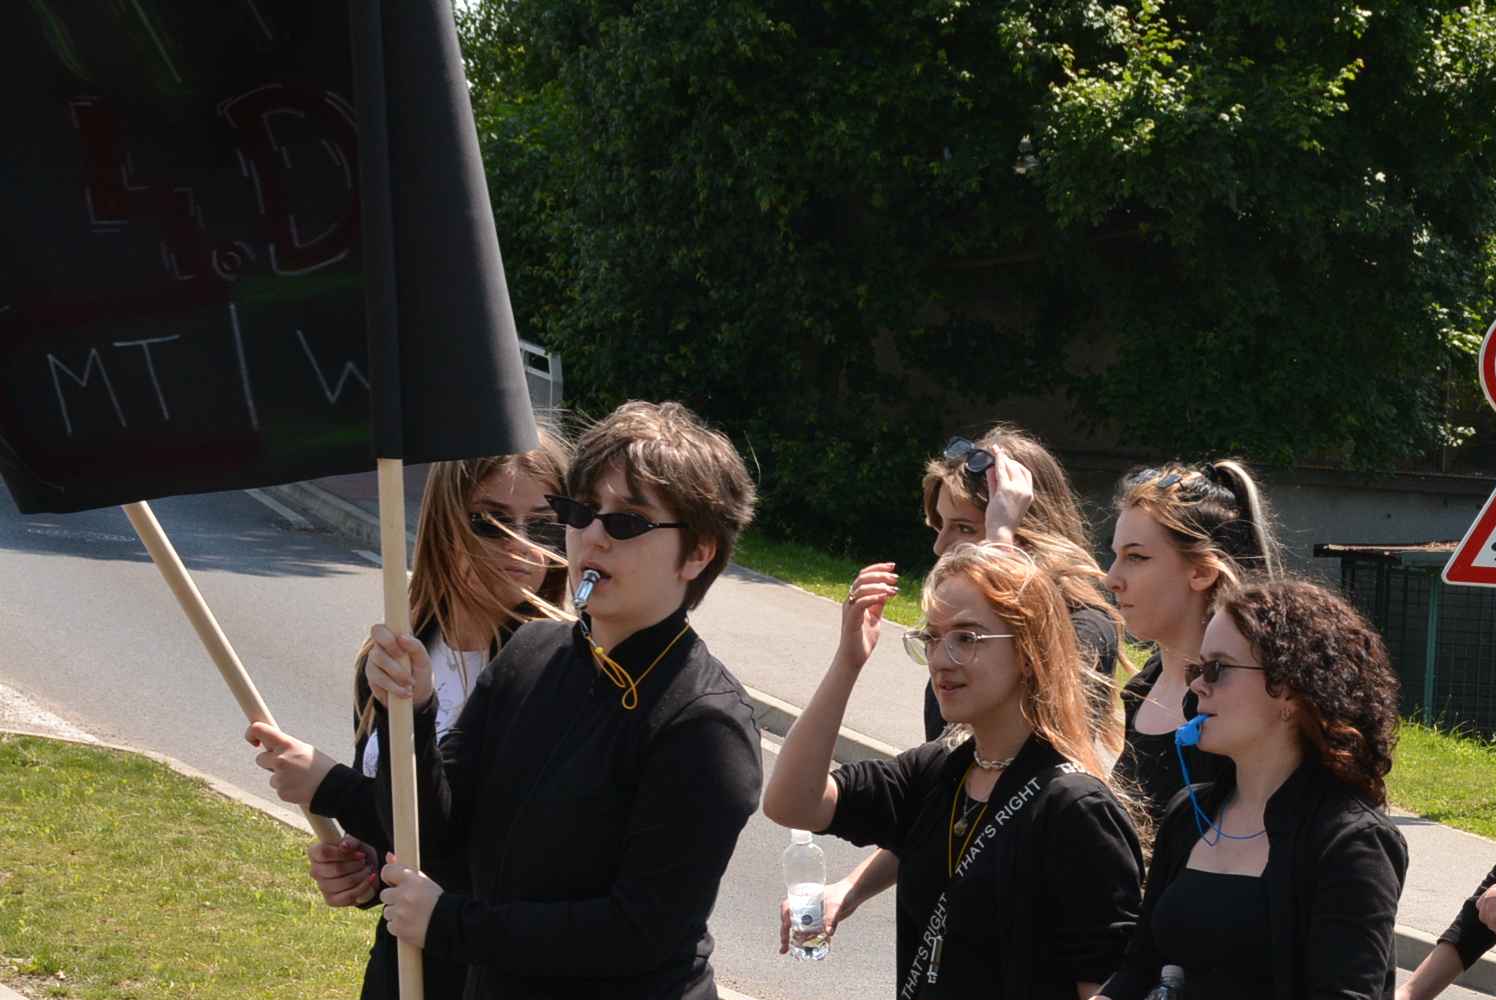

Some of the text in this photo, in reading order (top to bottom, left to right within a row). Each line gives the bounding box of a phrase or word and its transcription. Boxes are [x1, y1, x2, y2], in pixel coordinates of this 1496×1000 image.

[45, 333, 181, 437] MT
[955, 777, 1041, 877] THAT'S RIGHT
[900, 891, 948, 1000] THAT'S RIGHT
